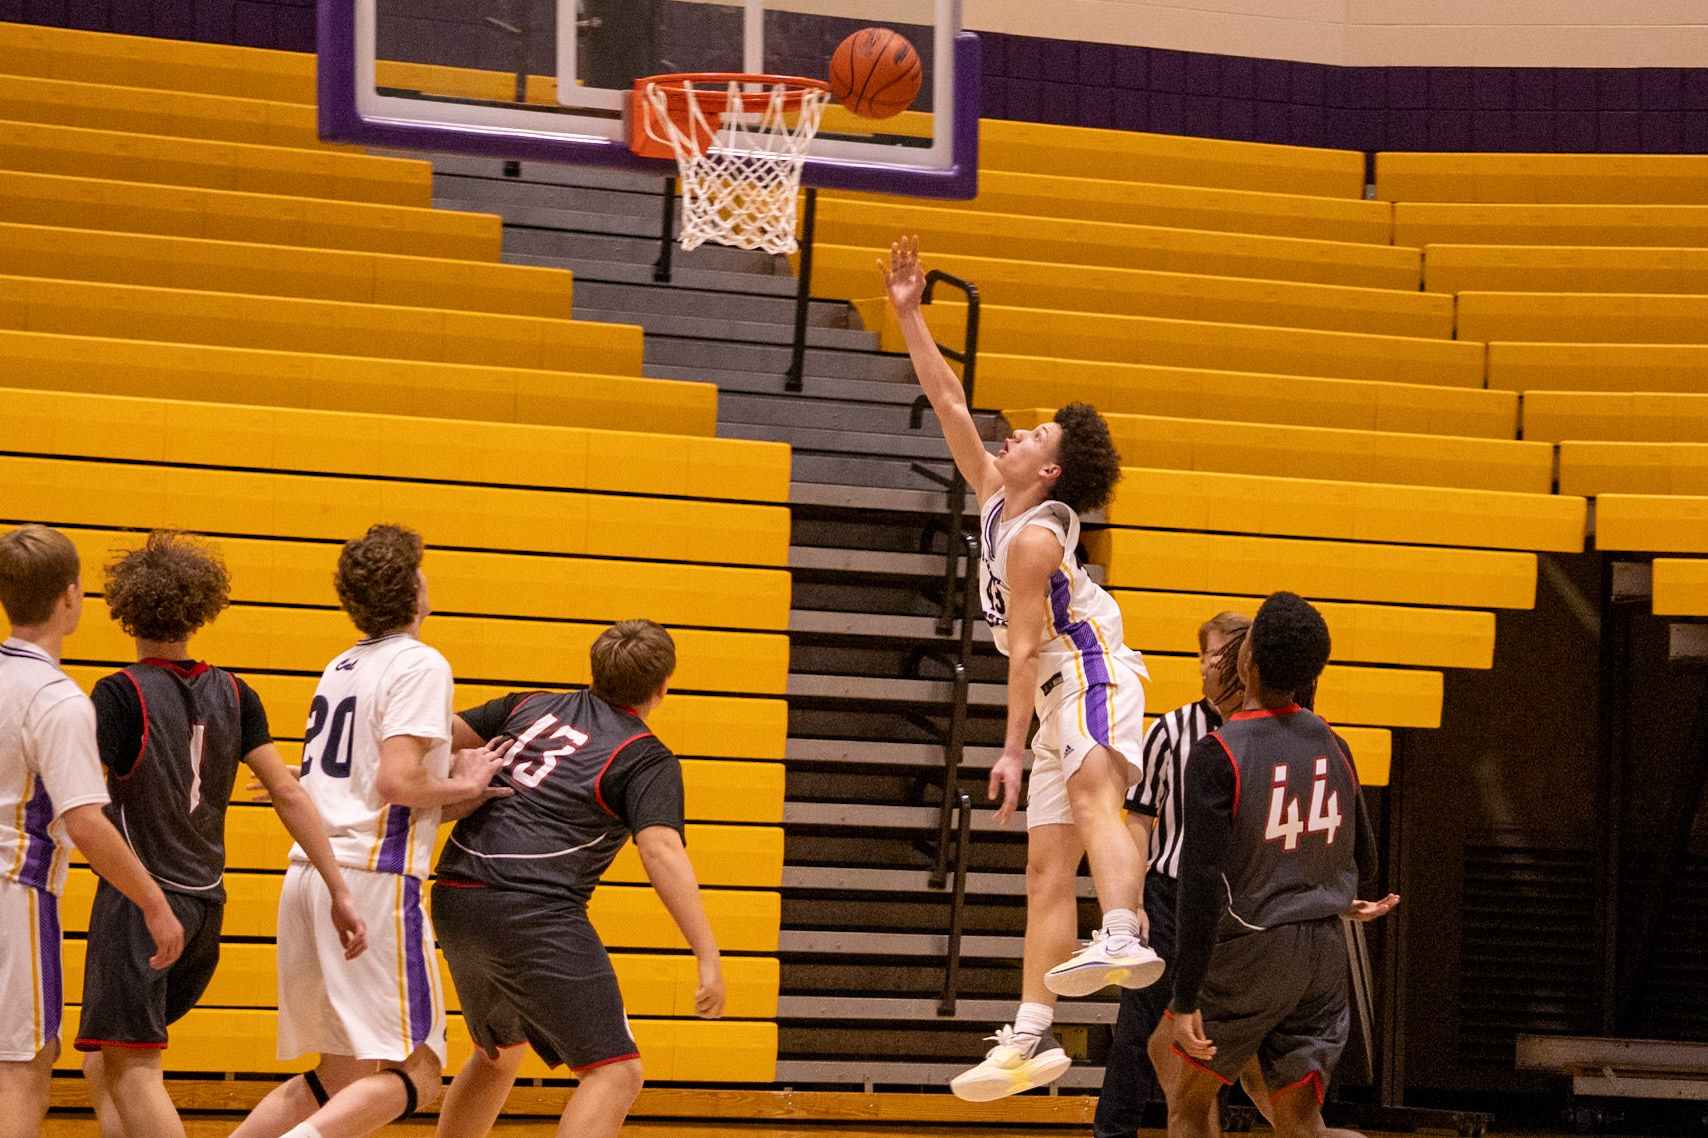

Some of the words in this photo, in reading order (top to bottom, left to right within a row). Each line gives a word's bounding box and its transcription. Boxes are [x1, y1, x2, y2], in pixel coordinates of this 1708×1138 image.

[189, 723, 205, 815] 1
[300, 694, 357, 778] 20
[501, 712, 590, 789] 13
[1263, 756, 1343, 852] 44
